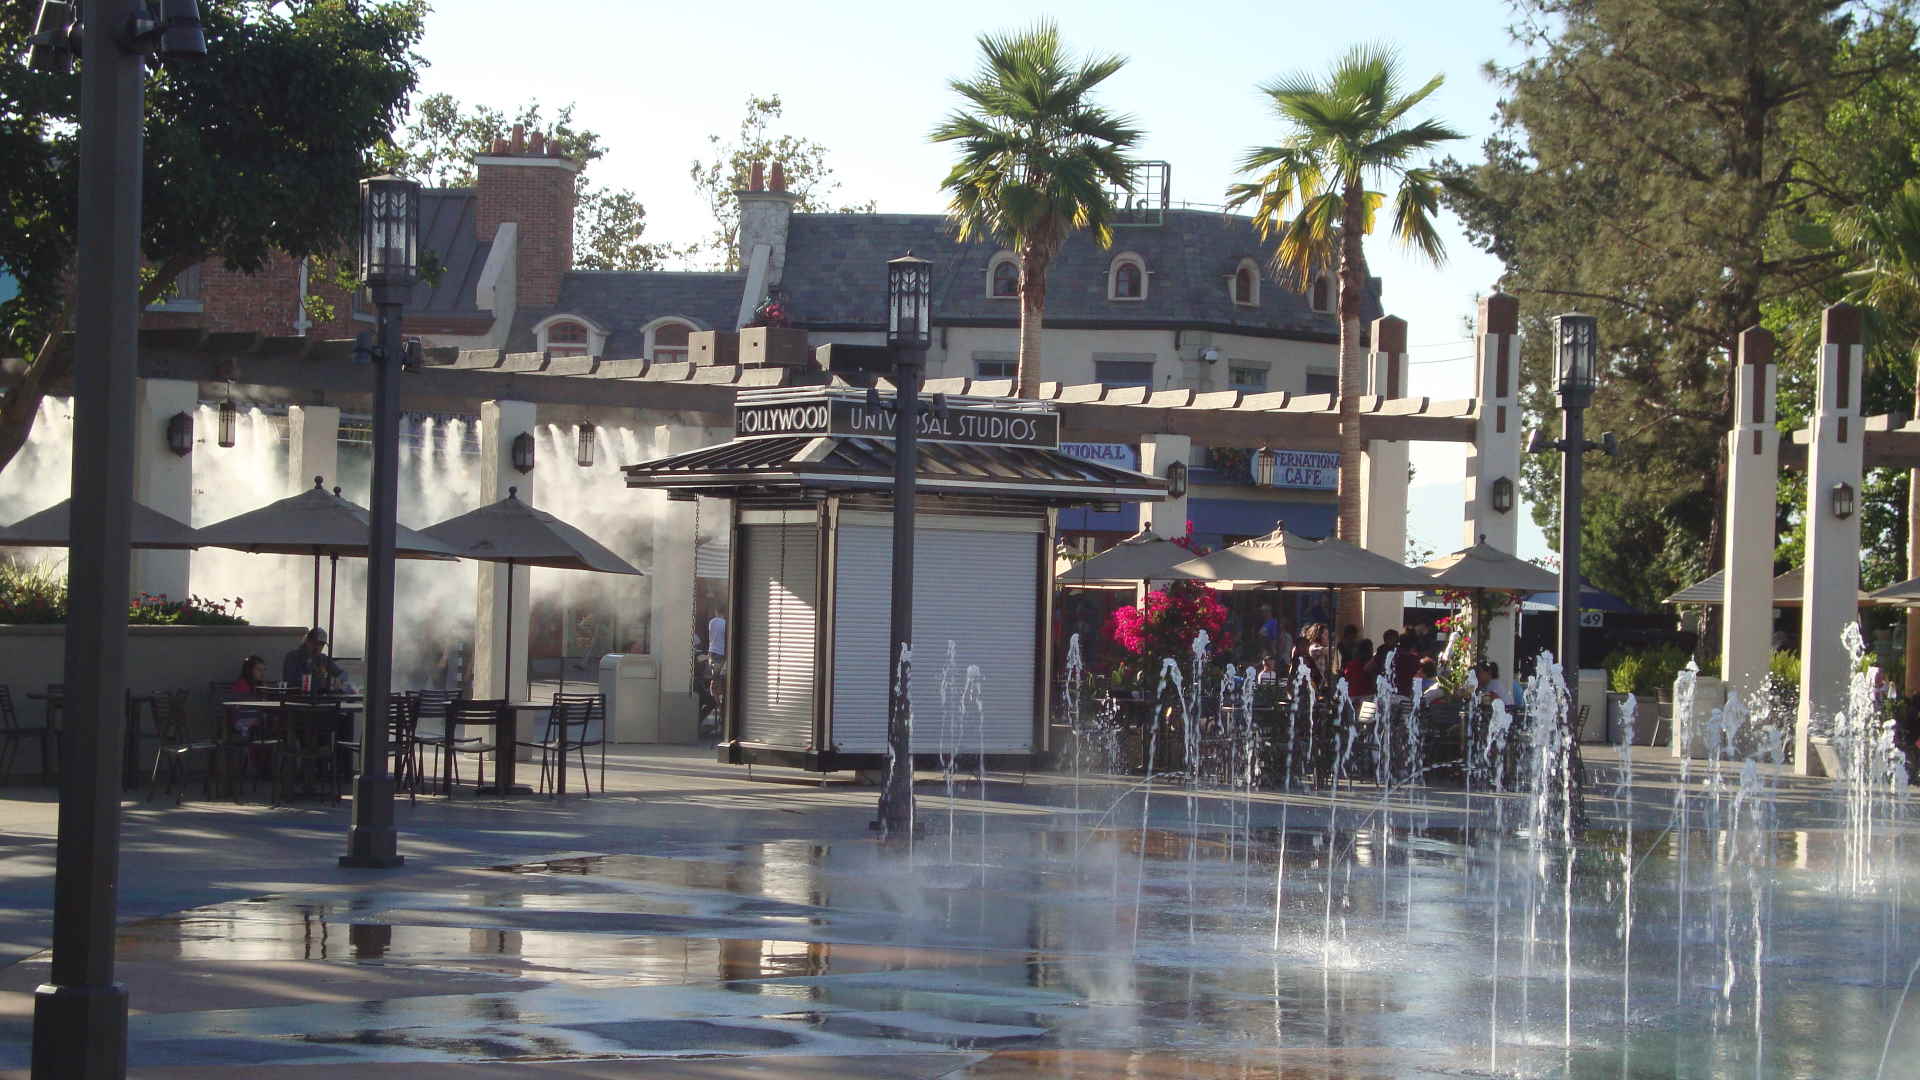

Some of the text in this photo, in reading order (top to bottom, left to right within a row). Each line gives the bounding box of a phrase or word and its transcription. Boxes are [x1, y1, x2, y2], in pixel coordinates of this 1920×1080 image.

[738, 406, 828, 432] HOLLYWOOD
[851, 408, 1037, 441] UNIVSAL STUDIOS
[1061, 444, 1127, 460] TIONAL
[1285, 468, 1322, 485] CAFE
[1583, 613, 1601, 625] 49
